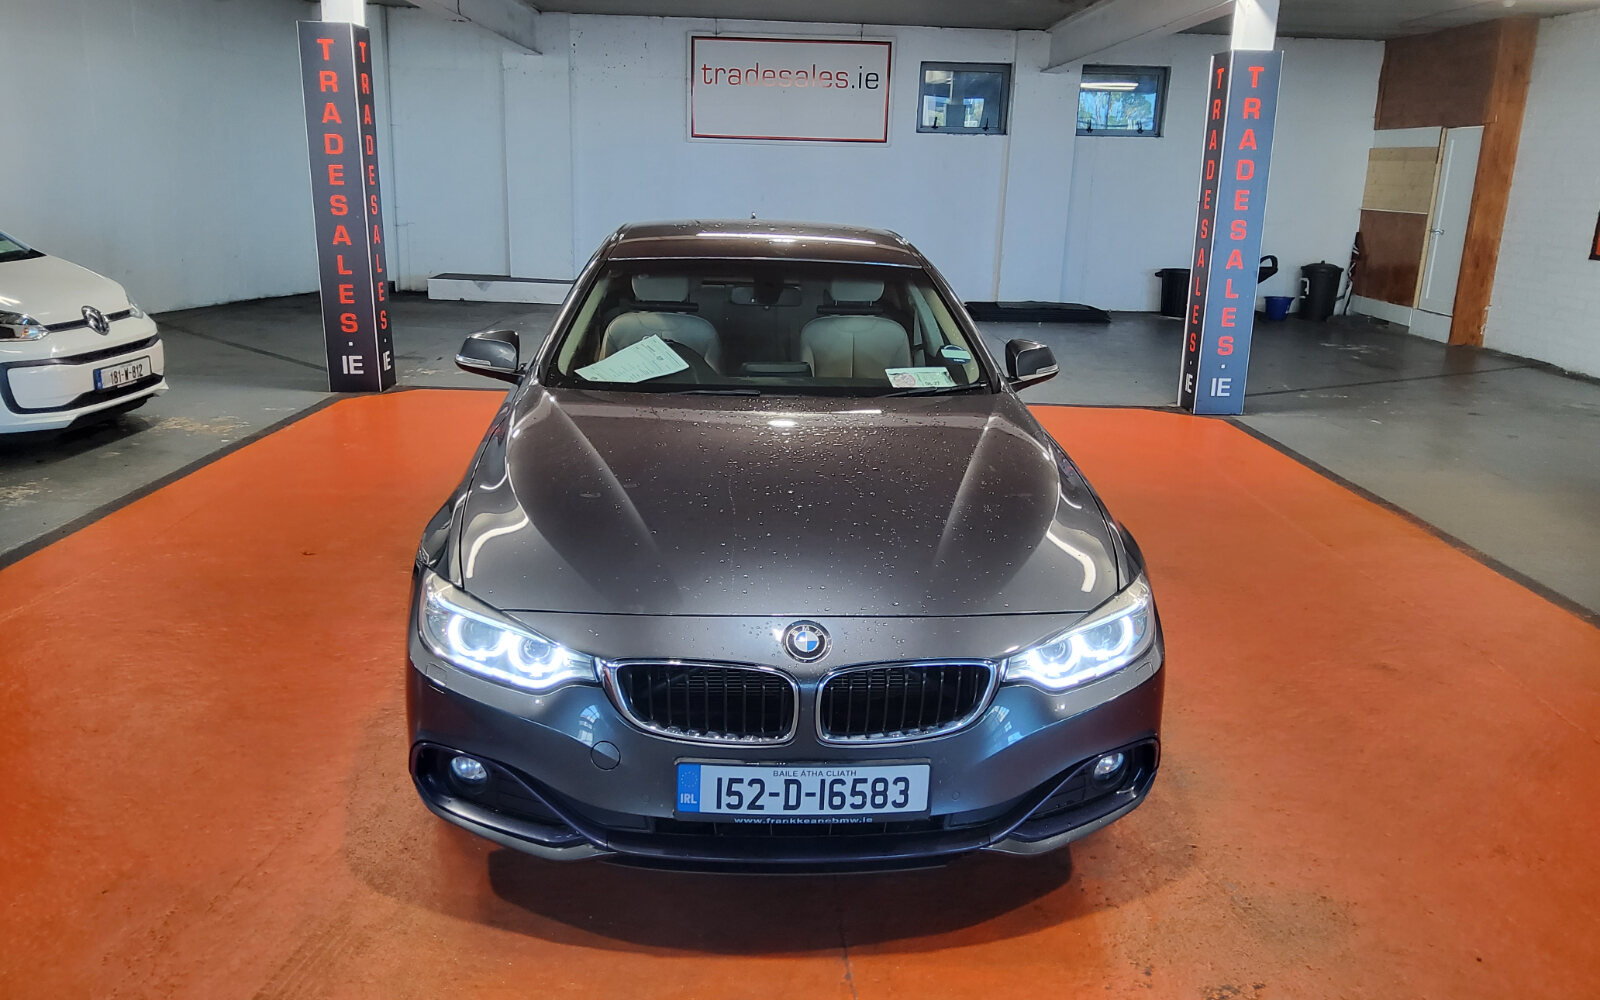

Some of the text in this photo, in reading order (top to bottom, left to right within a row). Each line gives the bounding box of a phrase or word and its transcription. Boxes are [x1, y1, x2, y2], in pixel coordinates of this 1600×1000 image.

[701, 62, 879, 90] tradesales.ie
[317, 38, 364, 375] TRADESALES.IE
[359, 41, 391, 371] TRADESALES.IE
[1185, 67, 1225, 394] TRADESALES.IE
[1210, 66, 1265, 397] TRADESALES.IE
[789, 625, 823, 638] BMW
[826, 769, 857, 777] CLIATH
[680, 793, 698, 804] IRL
[716, 776, 910, 811] 152-D-16583
[734, 817, 873, 825] www.frankkeanebmw.ie
